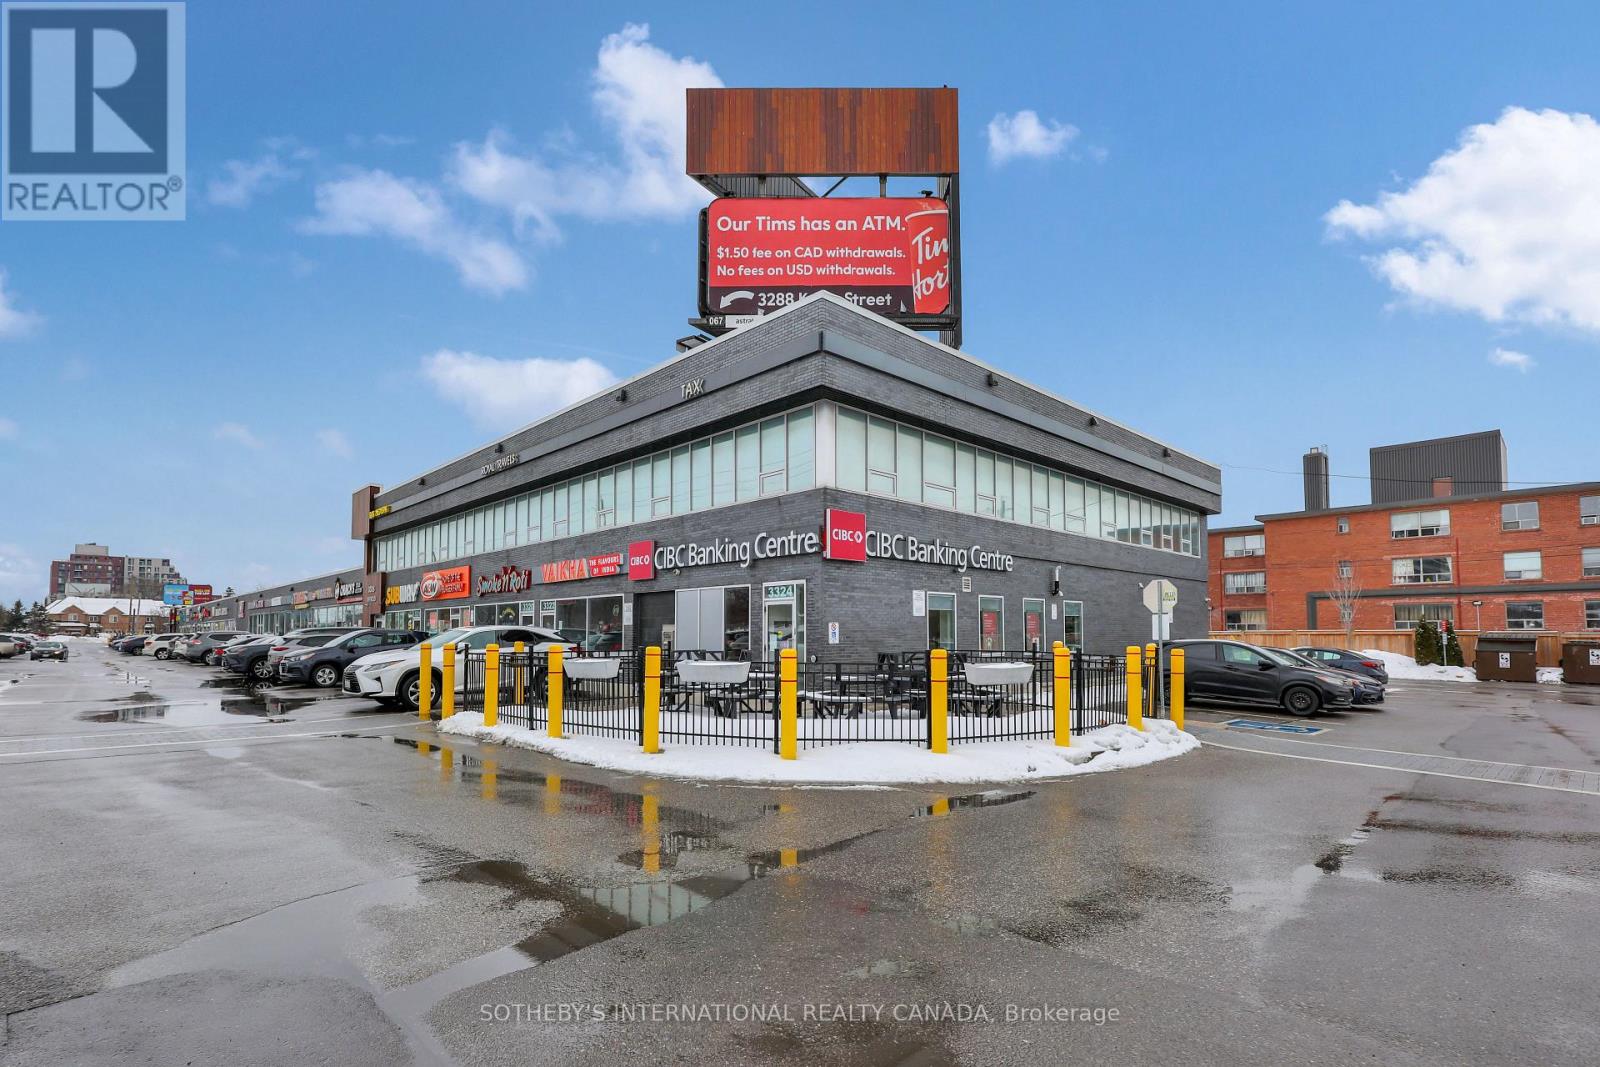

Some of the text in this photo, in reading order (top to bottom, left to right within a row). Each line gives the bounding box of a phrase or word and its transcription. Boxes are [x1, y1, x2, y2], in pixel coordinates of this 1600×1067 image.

[716, 216, 906, 232] Our Tims has an ATM.
[717, 246, 906, 260] $1.50 fee on CAD withdrawals.
[717, 264, 895, 276] No fees on USD withdrawals.
[757, 292, 794, 306] 3288
[844, 292, 892, 306] Street
[709, 316, 723, 325] 067
[832, 528, 854, 542] CIBC
[654, 530, 819, 570] CIBC Banking Centre
[866, 531, 1014, 573] CIBC Banking Centre
[768, 585, 793, 599] 3324
